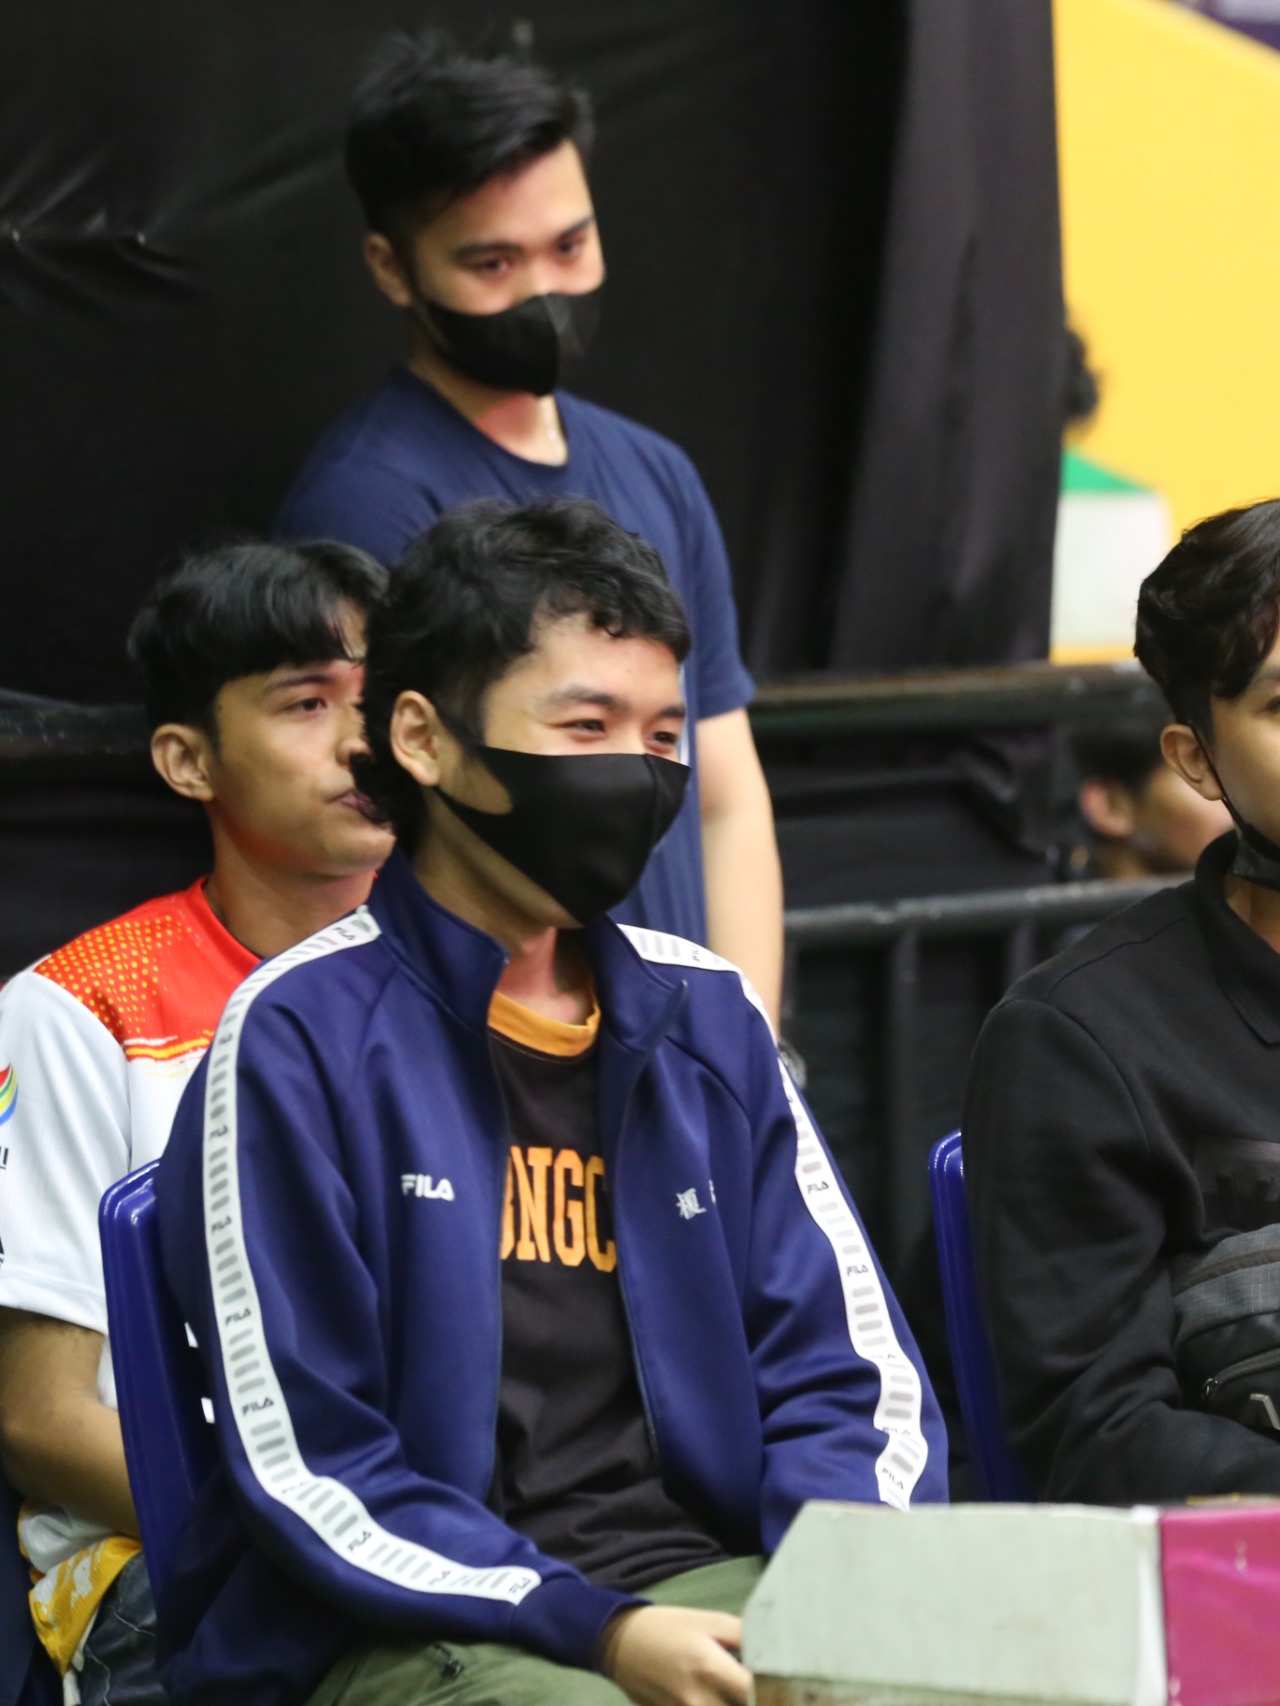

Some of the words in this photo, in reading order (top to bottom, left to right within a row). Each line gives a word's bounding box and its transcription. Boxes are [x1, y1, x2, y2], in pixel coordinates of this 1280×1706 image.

[401, 1174, 455, 1201] FILA
[807, 1181, 829, 1194] FILA
[846, 1264, 869, 1276] FILA
[225, 1308, 251, 1326] FILA
[242, 1397, 274, 1416] FILA
